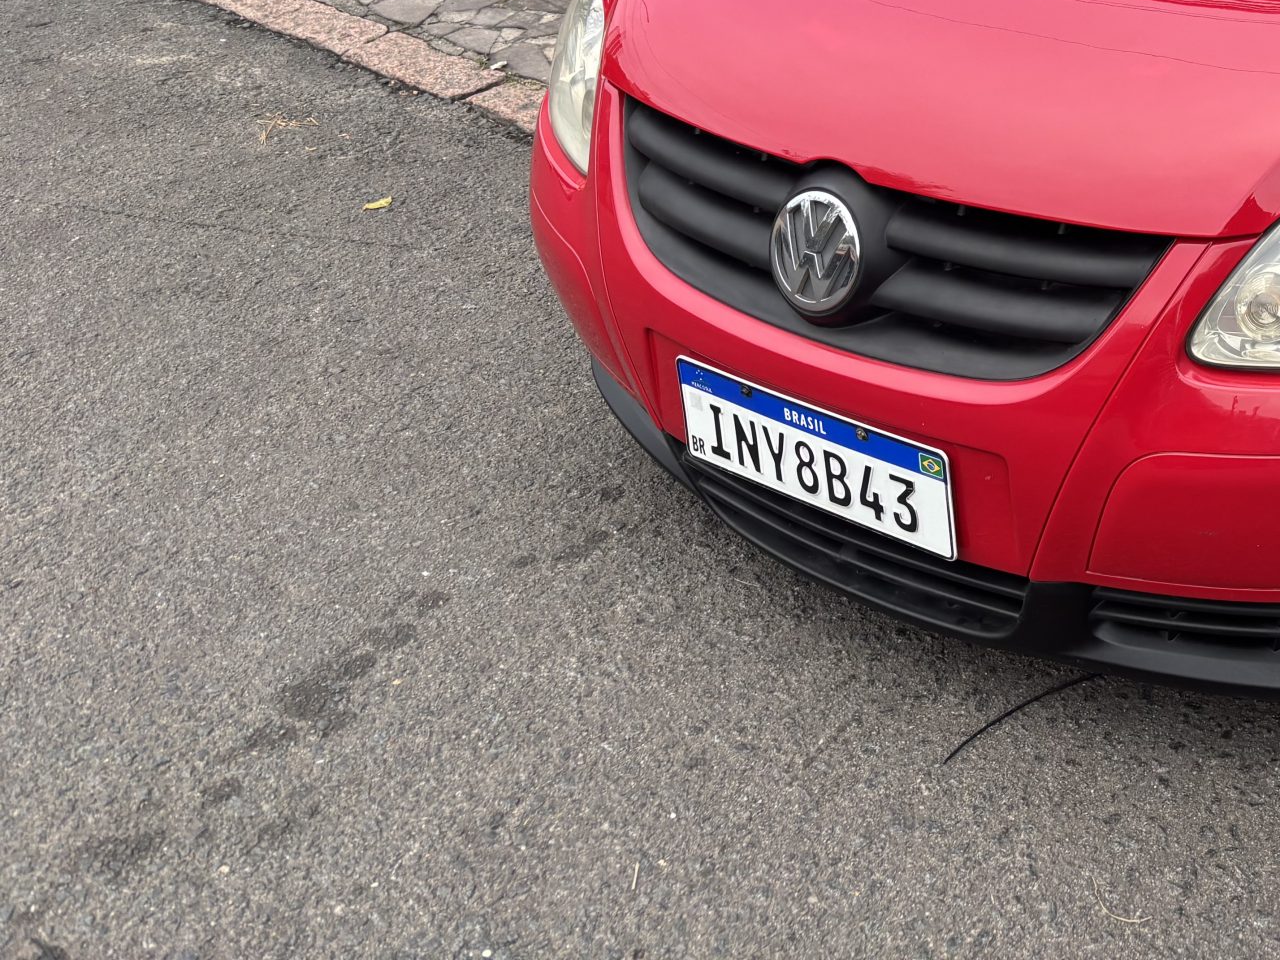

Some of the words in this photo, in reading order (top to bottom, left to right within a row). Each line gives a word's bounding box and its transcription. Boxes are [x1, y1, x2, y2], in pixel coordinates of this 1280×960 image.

[783, 407, 827, 435] BRASIL
[691, 435, 706, 456] BR
[709, 403, 918, 533] INY8B43
